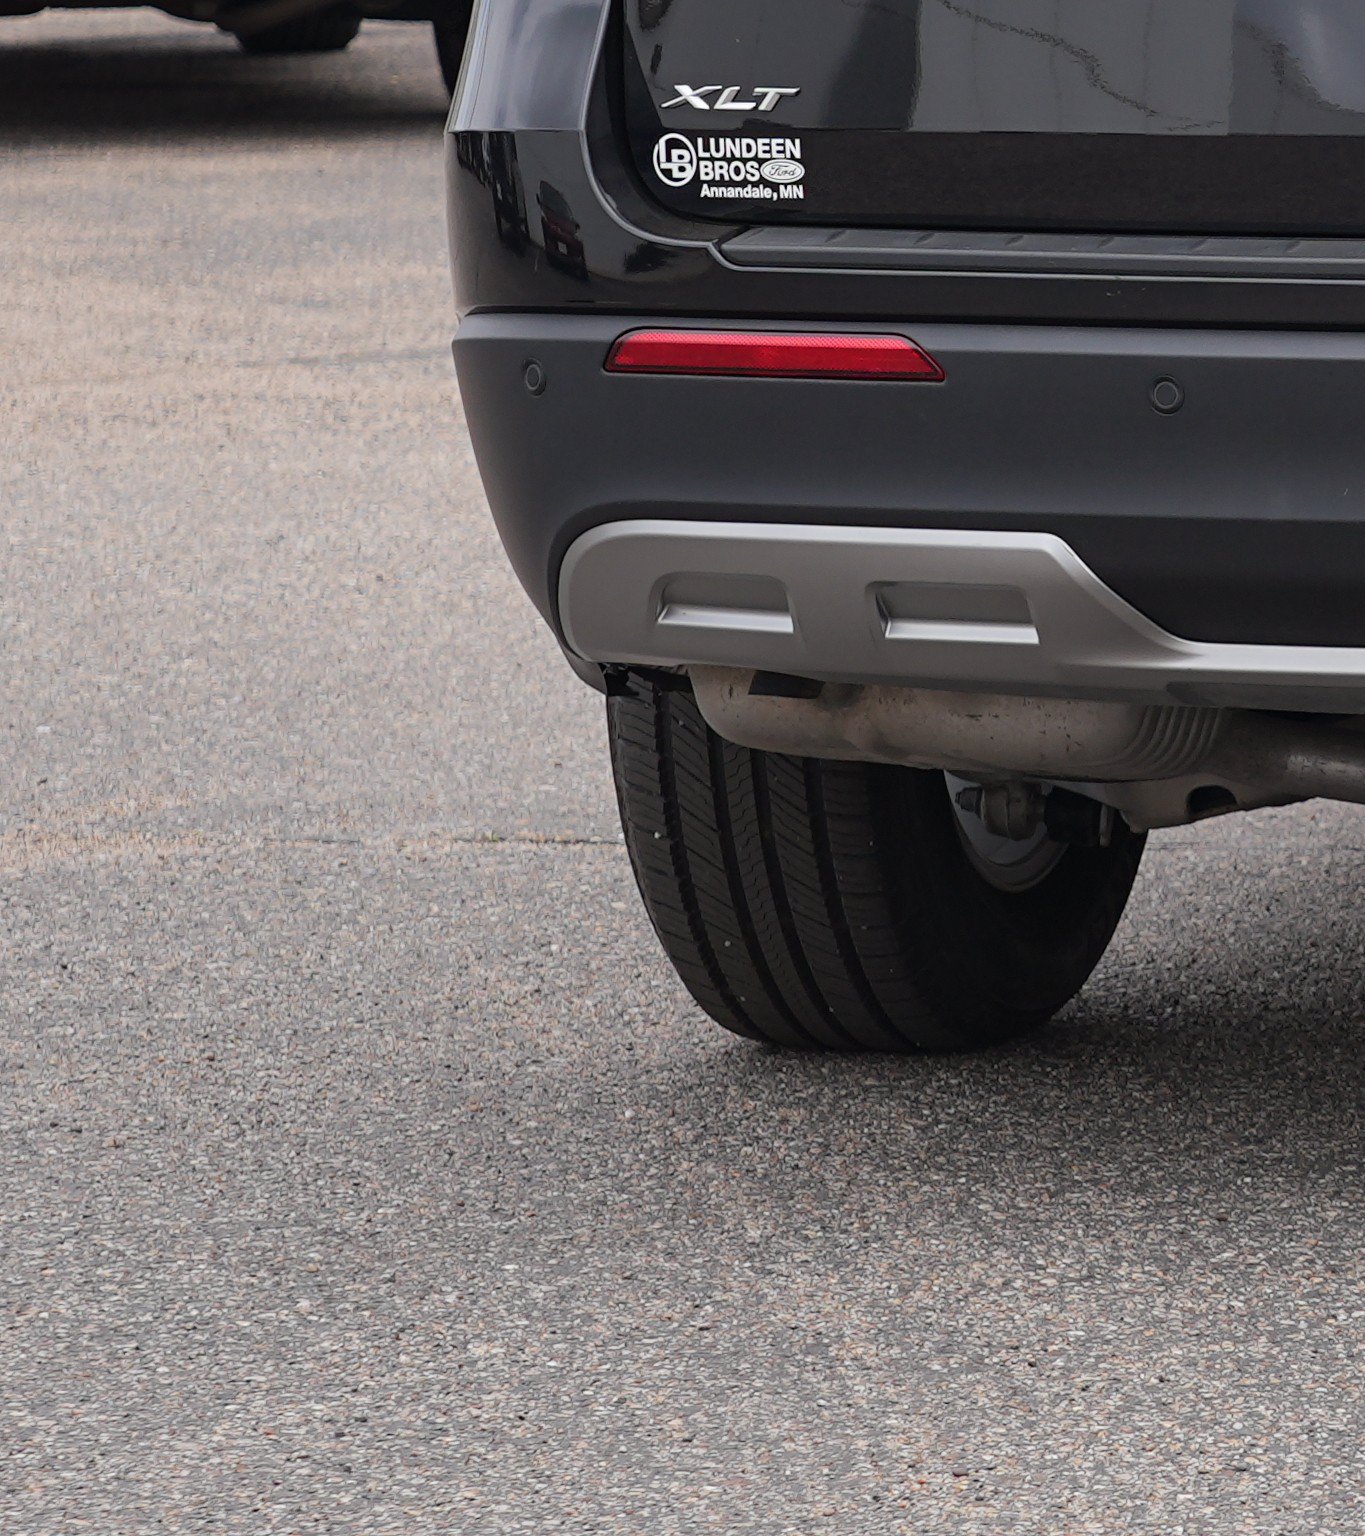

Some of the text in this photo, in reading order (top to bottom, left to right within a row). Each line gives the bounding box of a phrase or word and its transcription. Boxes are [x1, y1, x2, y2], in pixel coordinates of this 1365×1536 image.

[660, 84, 800, 112] XLT
[697, 137, 801, 159] LUNDEEN
[699, 160, 761, 182] BROS
[700, 183, 804, 201] Annandale, MN
